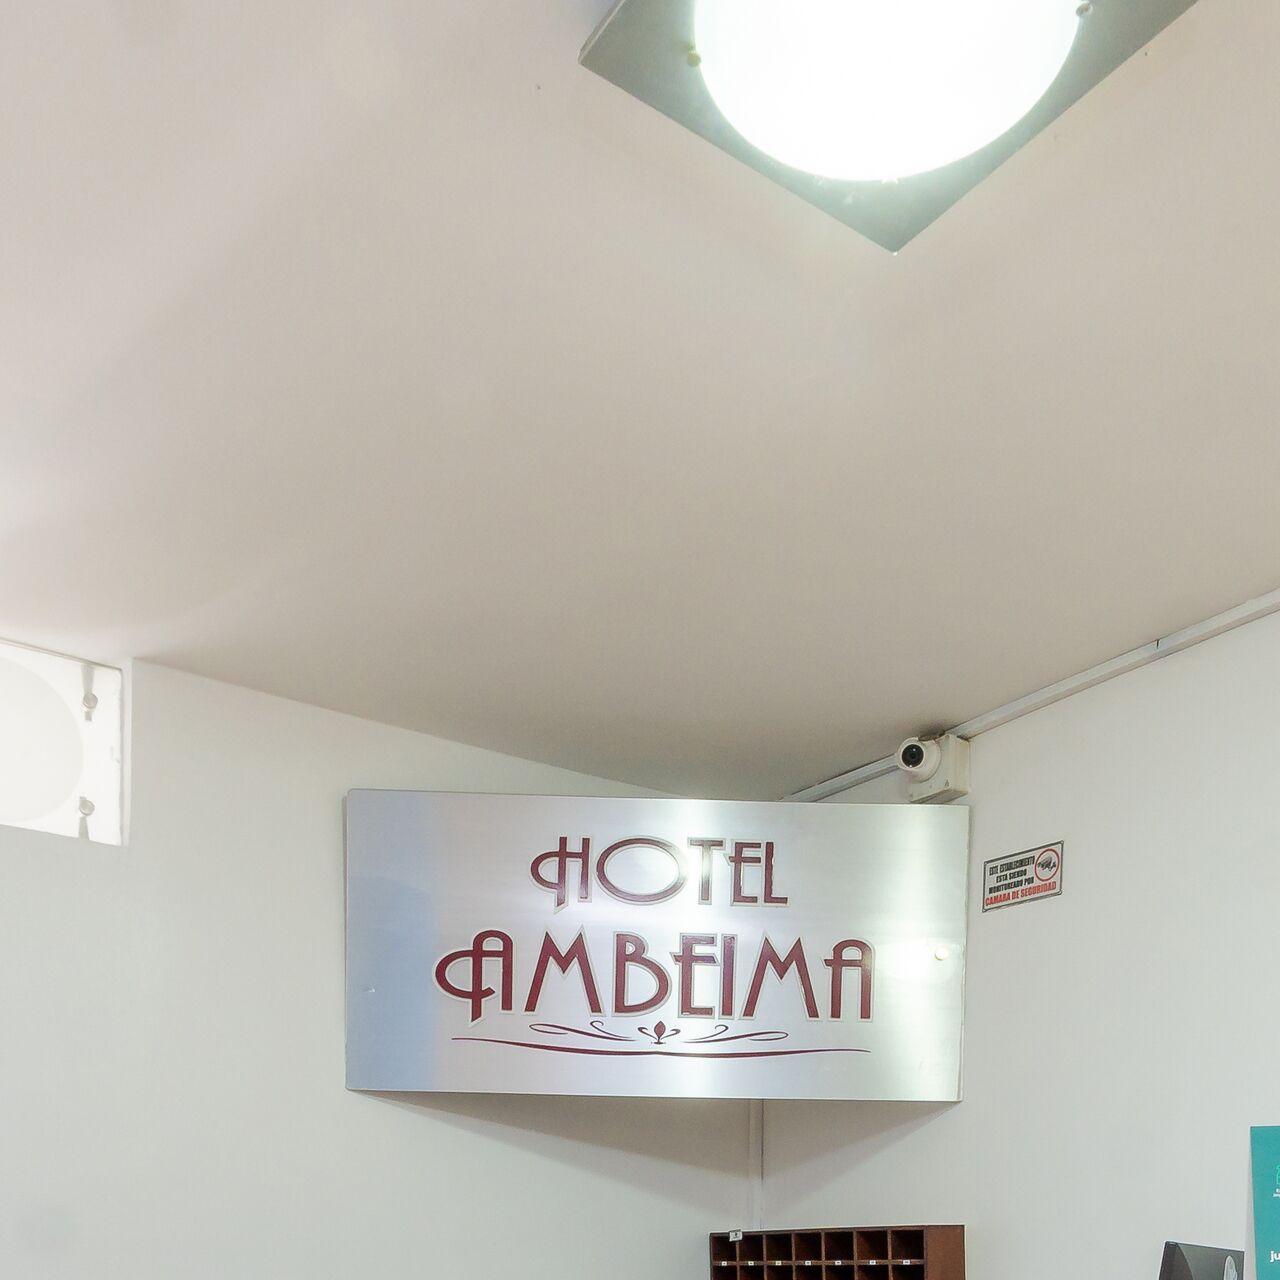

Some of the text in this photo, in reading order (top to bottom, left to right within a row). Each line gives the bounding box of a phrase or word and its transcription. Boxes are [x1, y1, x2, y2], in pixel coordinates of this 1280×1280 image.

[530, 835, 789, 911] HOTEL
[1009, 869, 1027, 880] SIENDO
[989, 877, 1034, 894] MONITOREADO POR
[1012, 890, 1019, 900] DE
[1021, 881, 1056, 898] SEGURIDAD
[433, 927, 874, 1023] AMBEIMA
